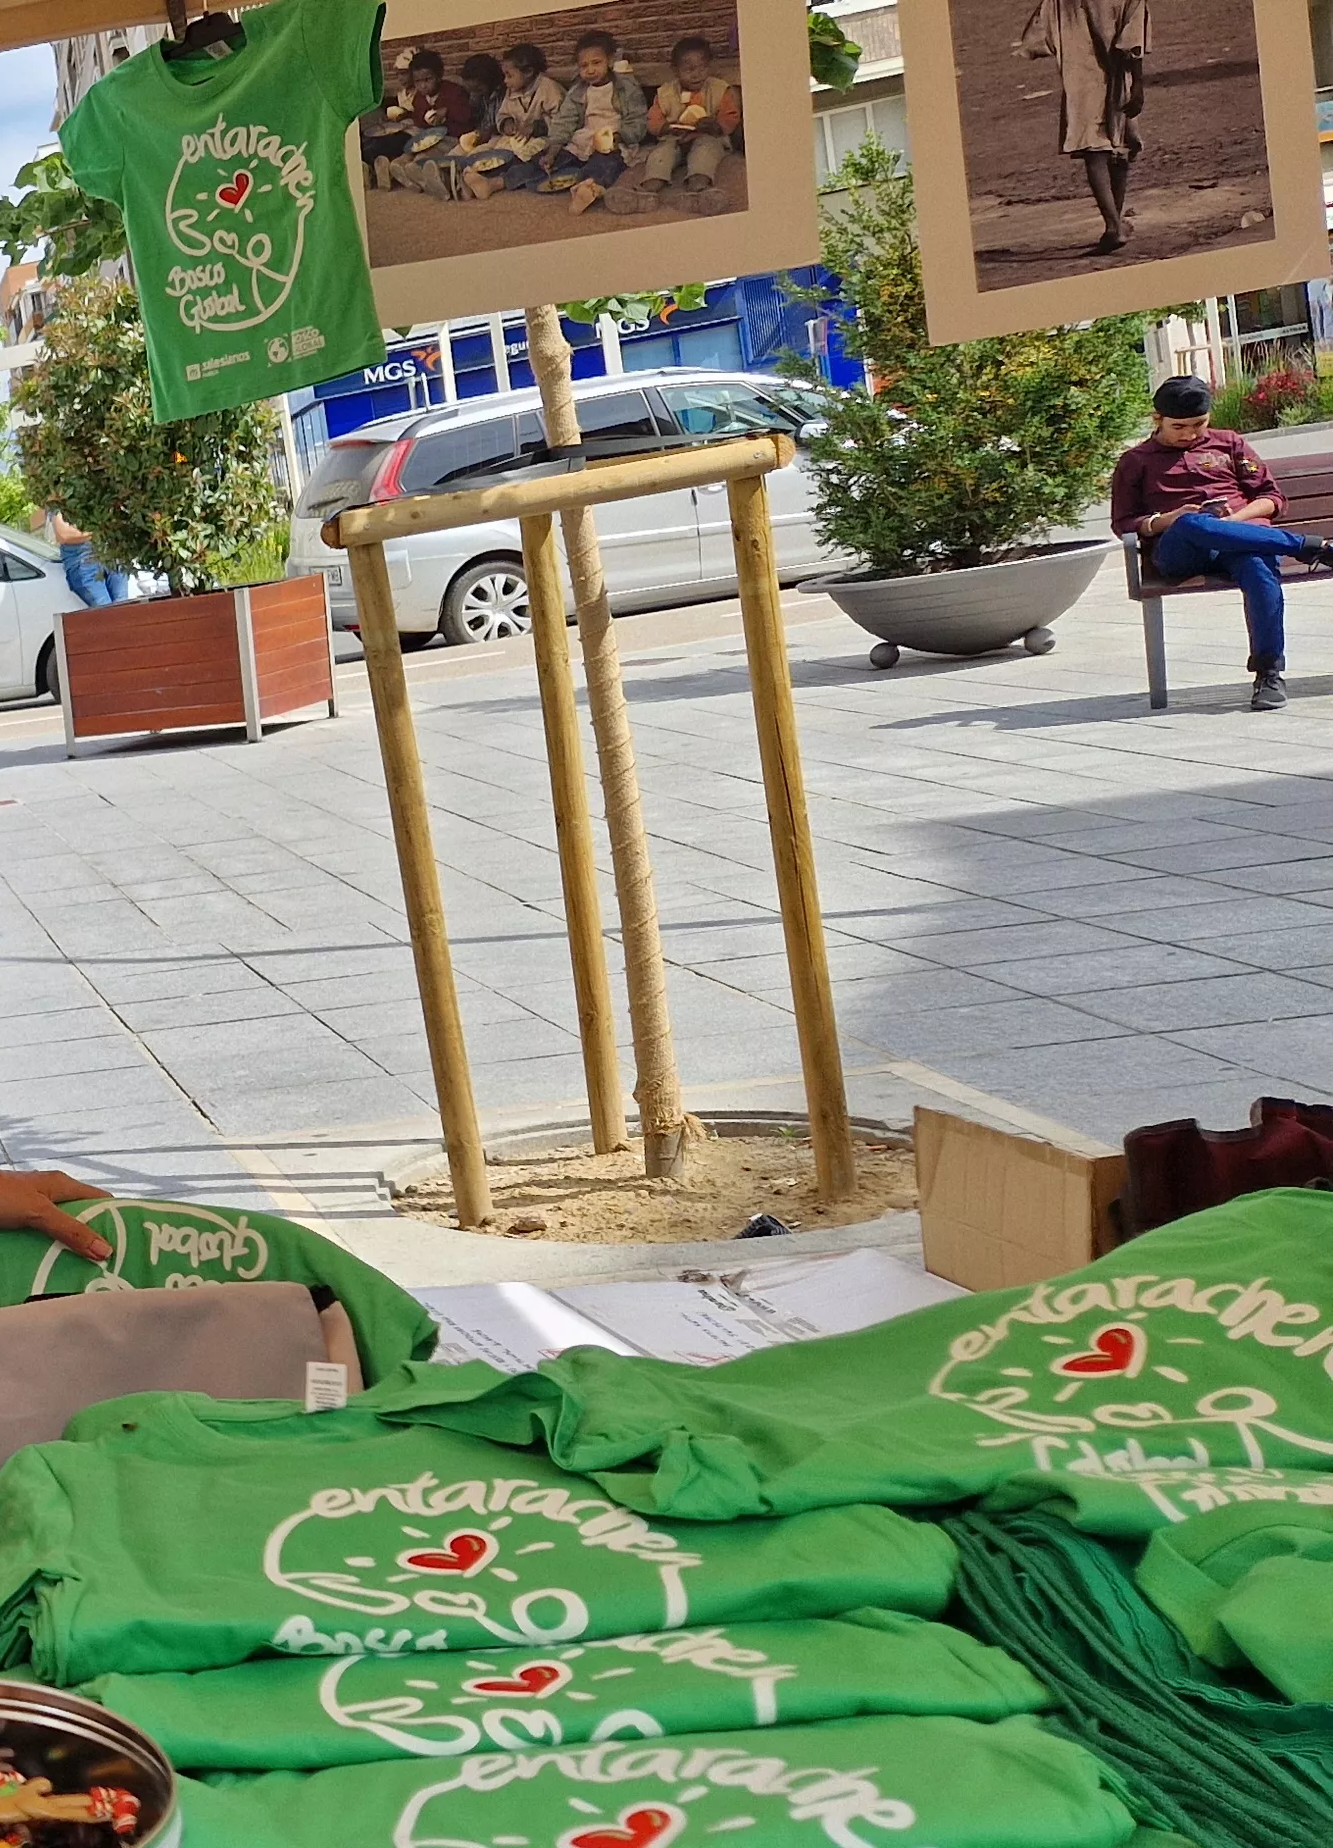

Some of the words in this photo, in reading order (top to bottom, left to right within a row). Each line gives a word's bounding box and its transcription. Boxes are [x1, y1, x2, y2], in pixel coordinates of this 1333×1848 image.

[165, 262, 226, 297] Bosco
[180, 283, 246, 334] Global
[363, 359, 418, 386] MGS
